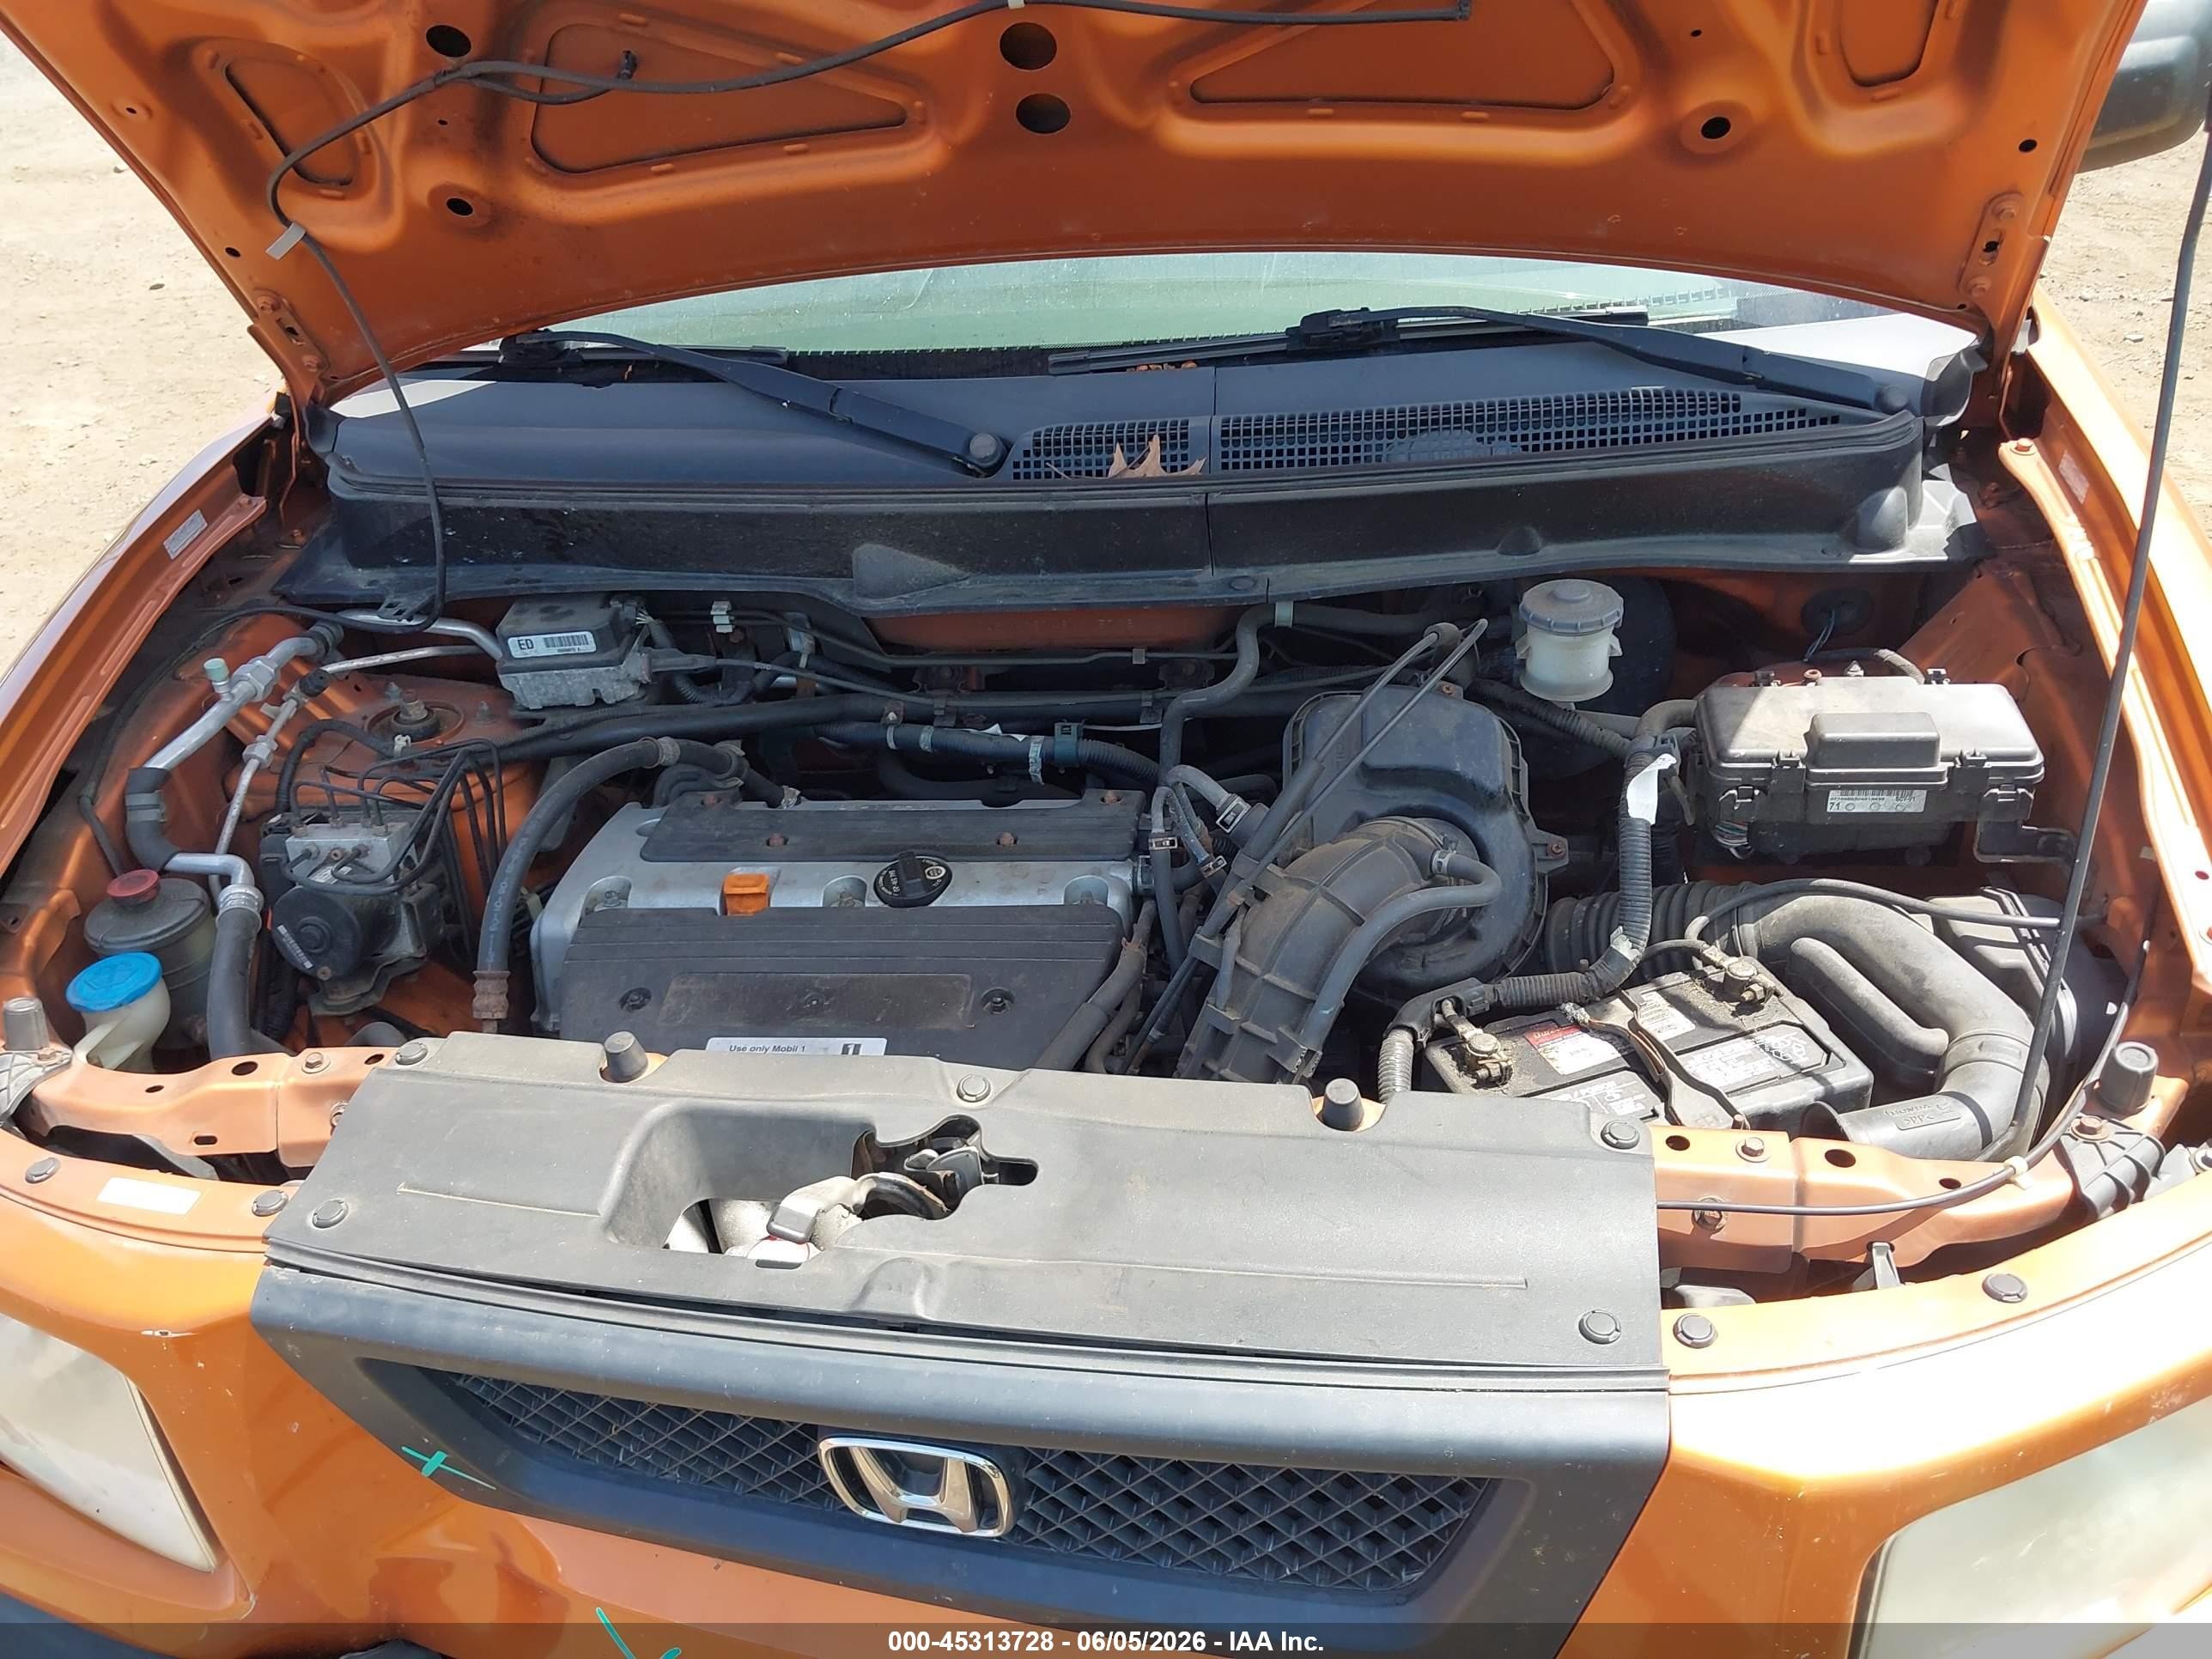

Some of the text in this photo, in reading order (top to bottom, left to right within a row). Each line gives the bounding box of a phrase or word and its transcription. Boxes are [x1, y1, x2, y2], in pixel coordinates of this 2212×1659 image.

[518, 638, 534, 650] ED
[1829, 802, 1841, 811] 71
[750, 1044, 770, 1054] only
[772, 1044, 799, 1053] Mobil
[800, 1044, 806, 1053] 1
